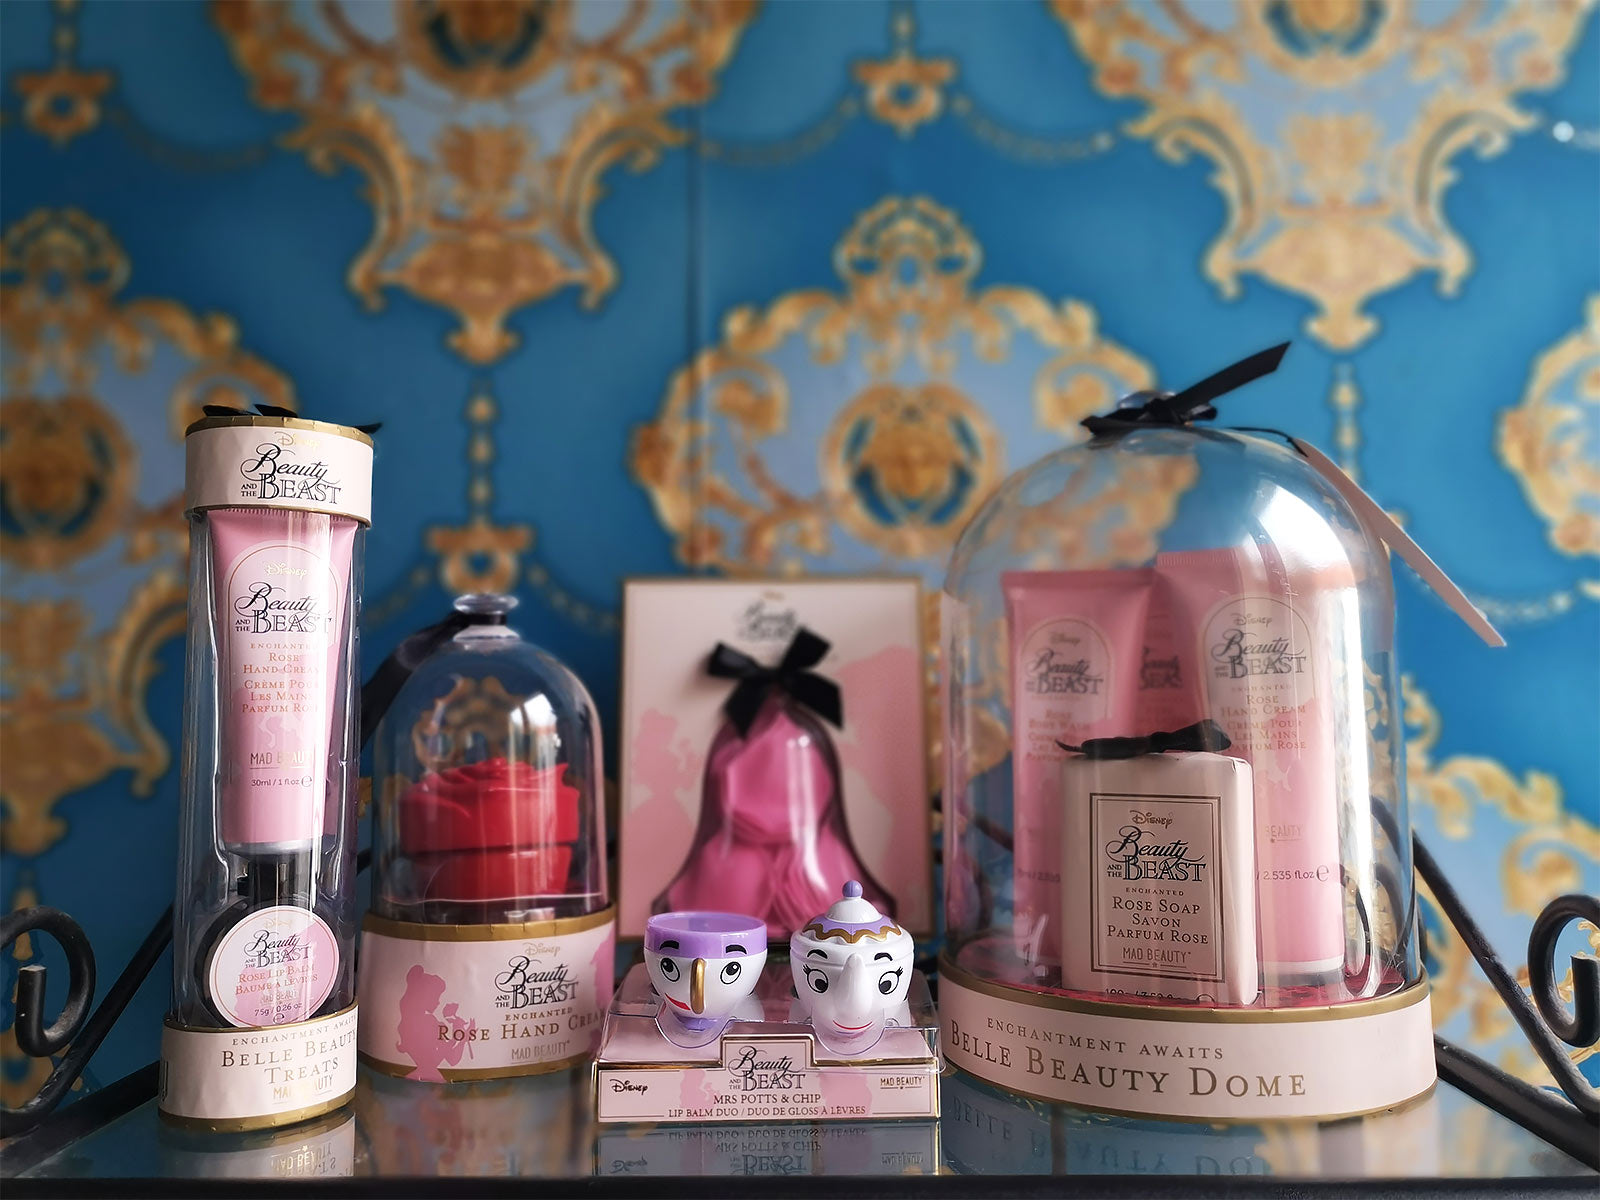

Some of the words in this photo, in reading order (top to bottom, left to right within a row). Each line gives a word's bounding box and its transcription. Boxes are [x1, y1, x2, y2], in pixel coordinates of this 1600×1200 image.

[241, 443, 340, 484] Beauty
[241, 484, 257, 492] AND
[258, 473, 341, 504] BEAST
[234, 582, 326, 617] Beauty
[1211, 629, 1304, 663] Beauty
[243, 664, 279, 675] HAND
[1229, 656, 1306, 679] BEAST
[251, 692, 272, 701] LES
[276, 691, 311, 701] MAIN
[1247, 694, 1279, 704] ROSE
[243, 704, 289, 713] PARFUM
[293, 703, 318, 713] RO
[1263, 705, 1306, 715] CREAM
[1277, 740, 1307, 750] ROSE
[251, 752, 273, 765] MAD
[251, 777, 272, 787] 30ml
[1129, 810, 1173, 829] Disney
[1106, 825, 1205, 862] Beauty
[1123, 854, 1206, 882] BEAST
[1126, 887, 1184, 897] ENCHANTED
[1112, 896, 1153, 911] ROSE
[1159, 899, 1201, 914] SOAP
[1132, 913, 1181, 928] SAVON
[244, 930, 310, 957] Beauty
[1107, 925, 1164, 940] PARFUM
[1171, 928, 1209, 944] ROSE
[256, 945, 312, 968] BEAST
[522, 942, 561, 957] Disney
[1123, 947, 1143, 961] MAD
[1147, 948, 1188, 964] BEAUTY
[238, 972, 266, 983] ROSE
[495, 955, 578, 993] Beauty
[235, 983, 272, 995] BAUME
[284, 974, 318, 986] LÈVRS
[510, 982, 579, 1010] BEAST
[505, 1007, 573, 1021] ENCHANTED
[232, 1026, 329, 1046] ENCHANTMENT
[438, 1024, 490, 1041] ROSE
[501, 1023, 560, 1040] HAND
[987, 1017, 1127, 1053] ENCHANTMENT
[1140, 1044, 1224, 1061] AWAITS
[222, 1049, 293, 1067] BELLE
[511, 1047, 532, 1060] MAD
[728, 1046, 805, 1077] Beauty
[951, 1018, 1012, 1069] BELLE
[1026, 1046, 1170, 1094] BEAUTY
[1189, 1067, 1307, 1098] DOME
[264, 1057, 339, 1085] TREATS
[610, 1078, 649, 1096] Disney
[742, 1071, 806, 1092] BEAST
[881, 1076, 895, 1087] MAD
[896, 1075, 923, 1086] BEAUTY
[713, 1094, 739, 1104] MRS
[741, 1094, 779, 1104] POTTS
[780, 1094, 790, 1104] &
[791, 1093, 821, 1104] CHIP
[668, 1107, 684, 1118] LIP
[686, 1107, 714, 1118] BALM
[716, 1106, 740, 1117] DUO
[747, 1106, 772, 1117] DUO
[773, 1106, 785, 1116] DE
[787, 1106, 820, 1116] GLOSS
[821, 1104, 829, 1116] À
[830, 1103, 866, 1116] LÈVRES
